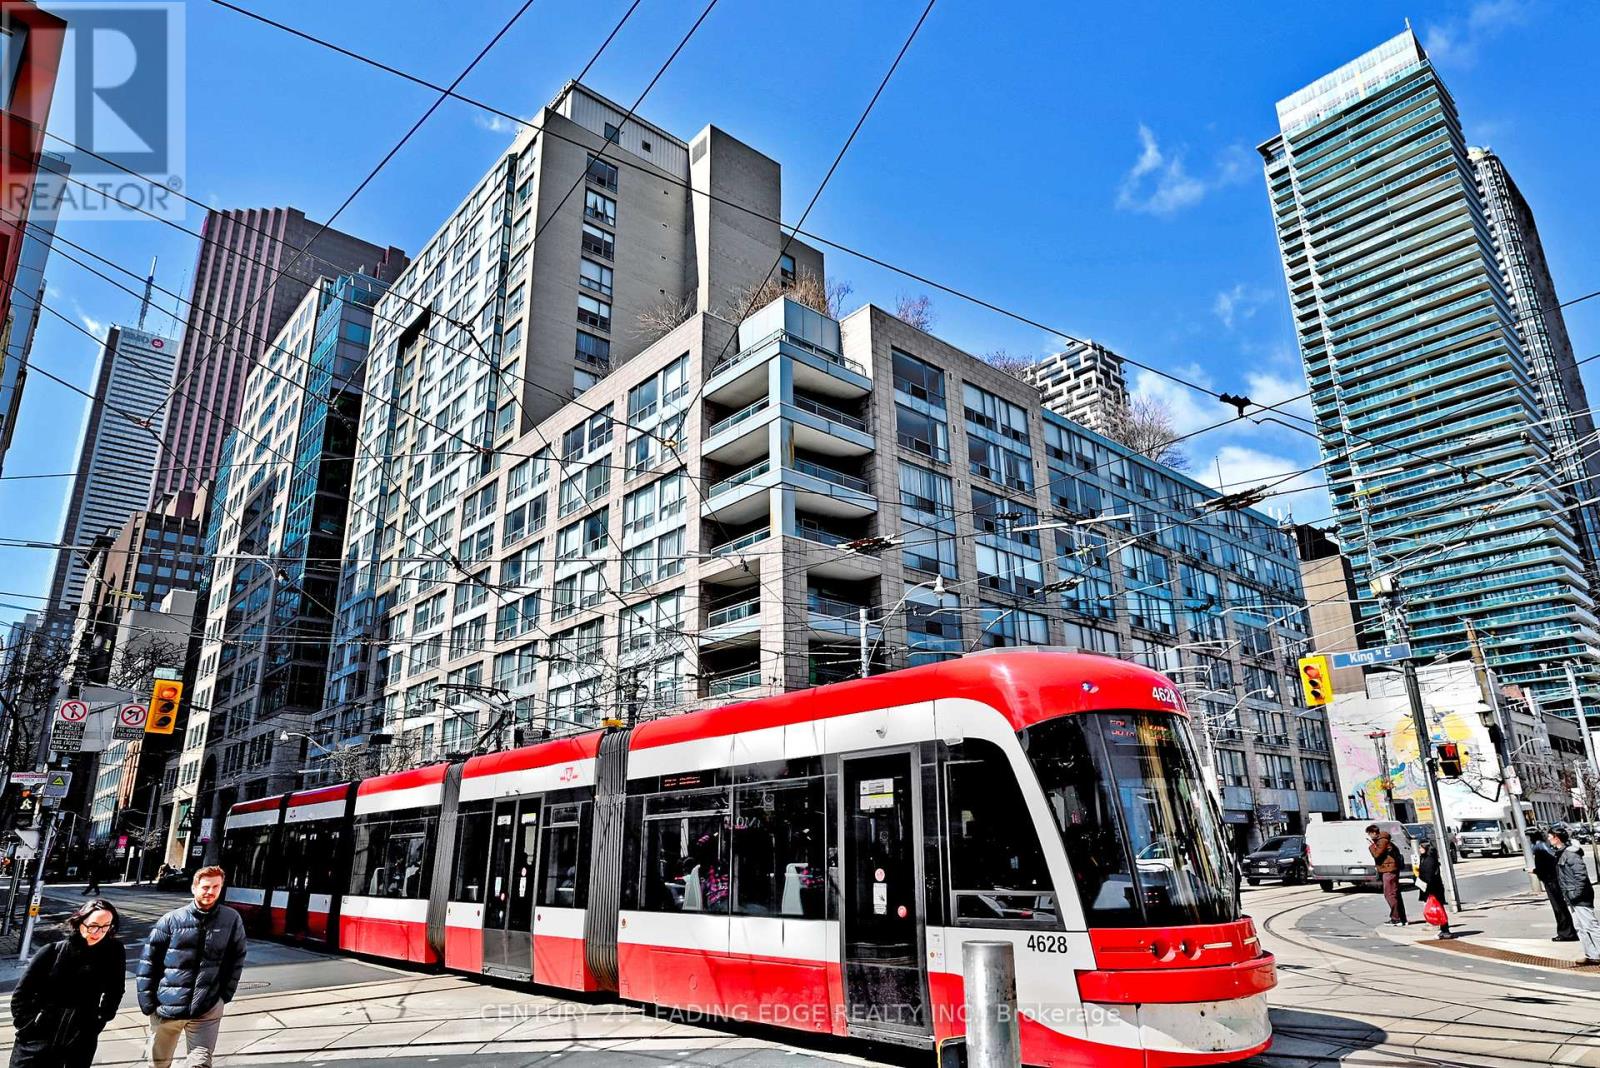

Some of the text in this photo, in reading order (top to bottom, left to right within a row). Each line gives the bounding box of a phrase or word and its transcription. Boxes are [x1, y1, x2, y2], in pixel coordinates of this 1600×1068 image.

[1349, 651, 1374, 663] King
[1383, 647, 1392, 658] E
[1027, 934, 1068, 954] 4628
